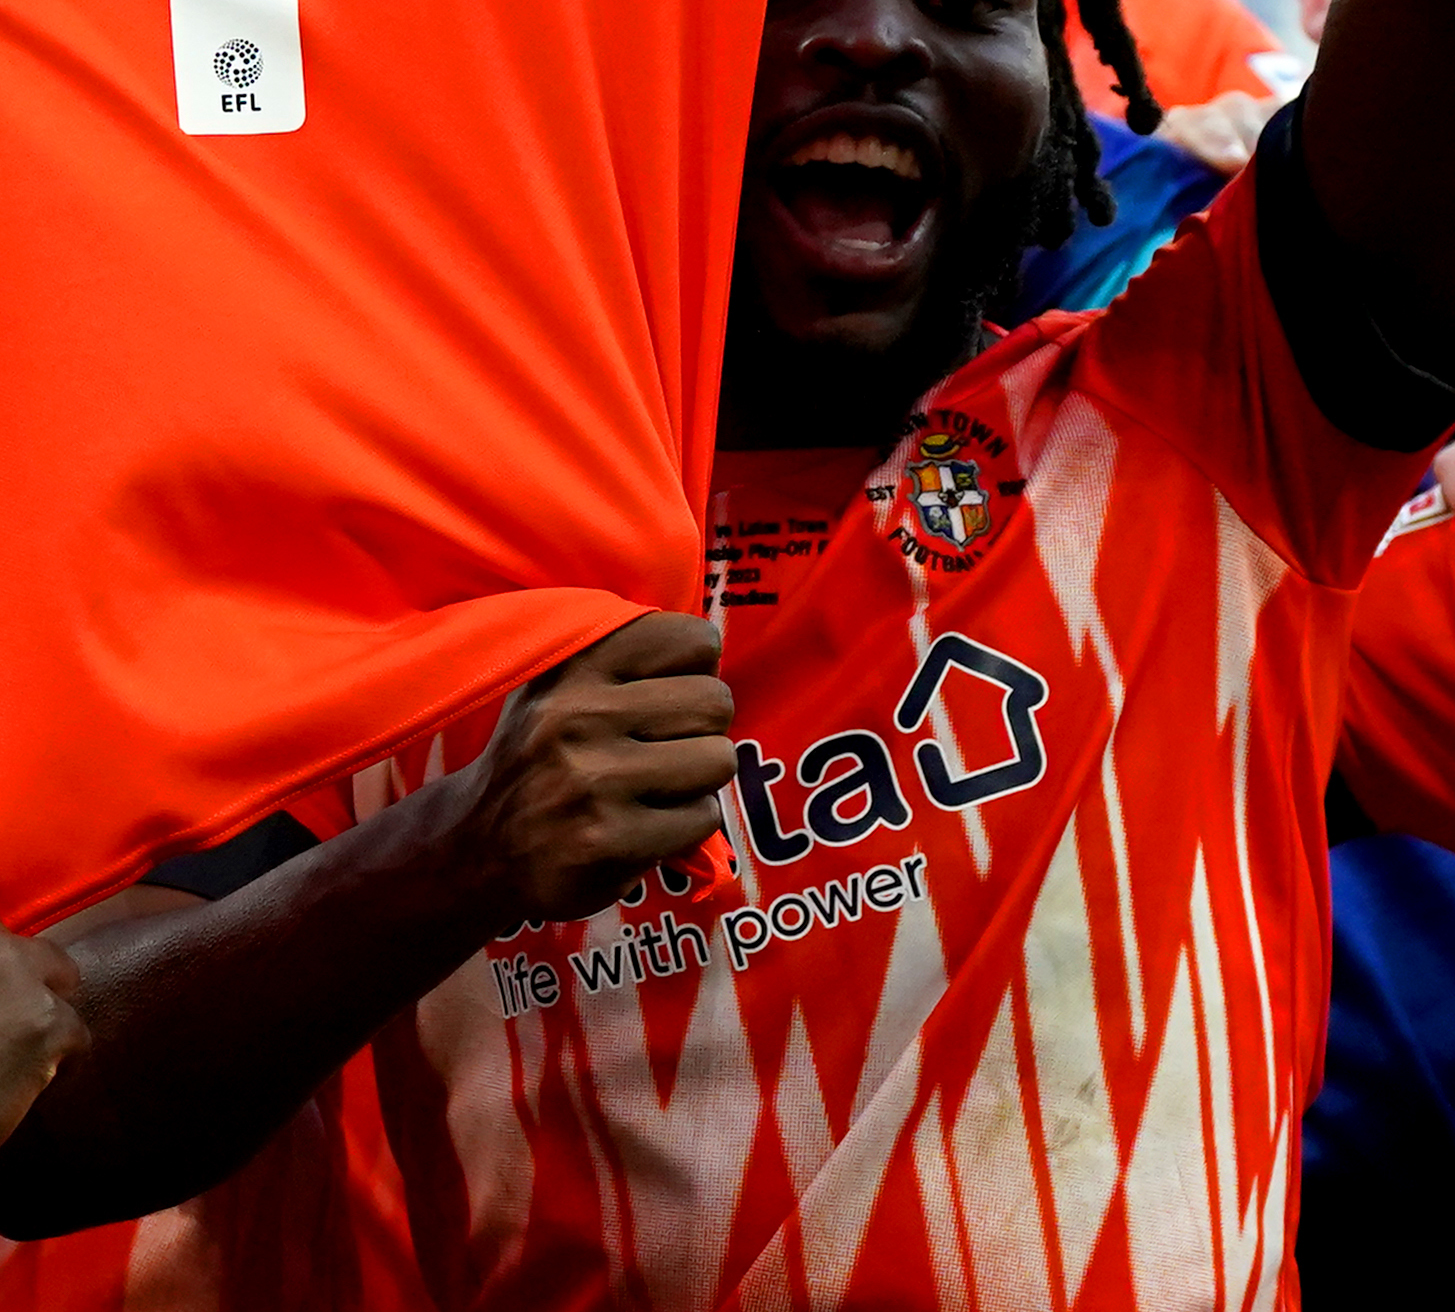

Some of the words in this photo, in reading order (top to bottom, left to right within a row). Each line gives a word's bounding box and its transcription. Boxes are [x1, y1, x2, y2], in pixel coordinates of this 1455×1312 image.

[220, 92, 262, 113] EFL
[490, 952, 561, 1020] life
[568, 910, 711, 996] with
[722, 851, 928, 972] power
